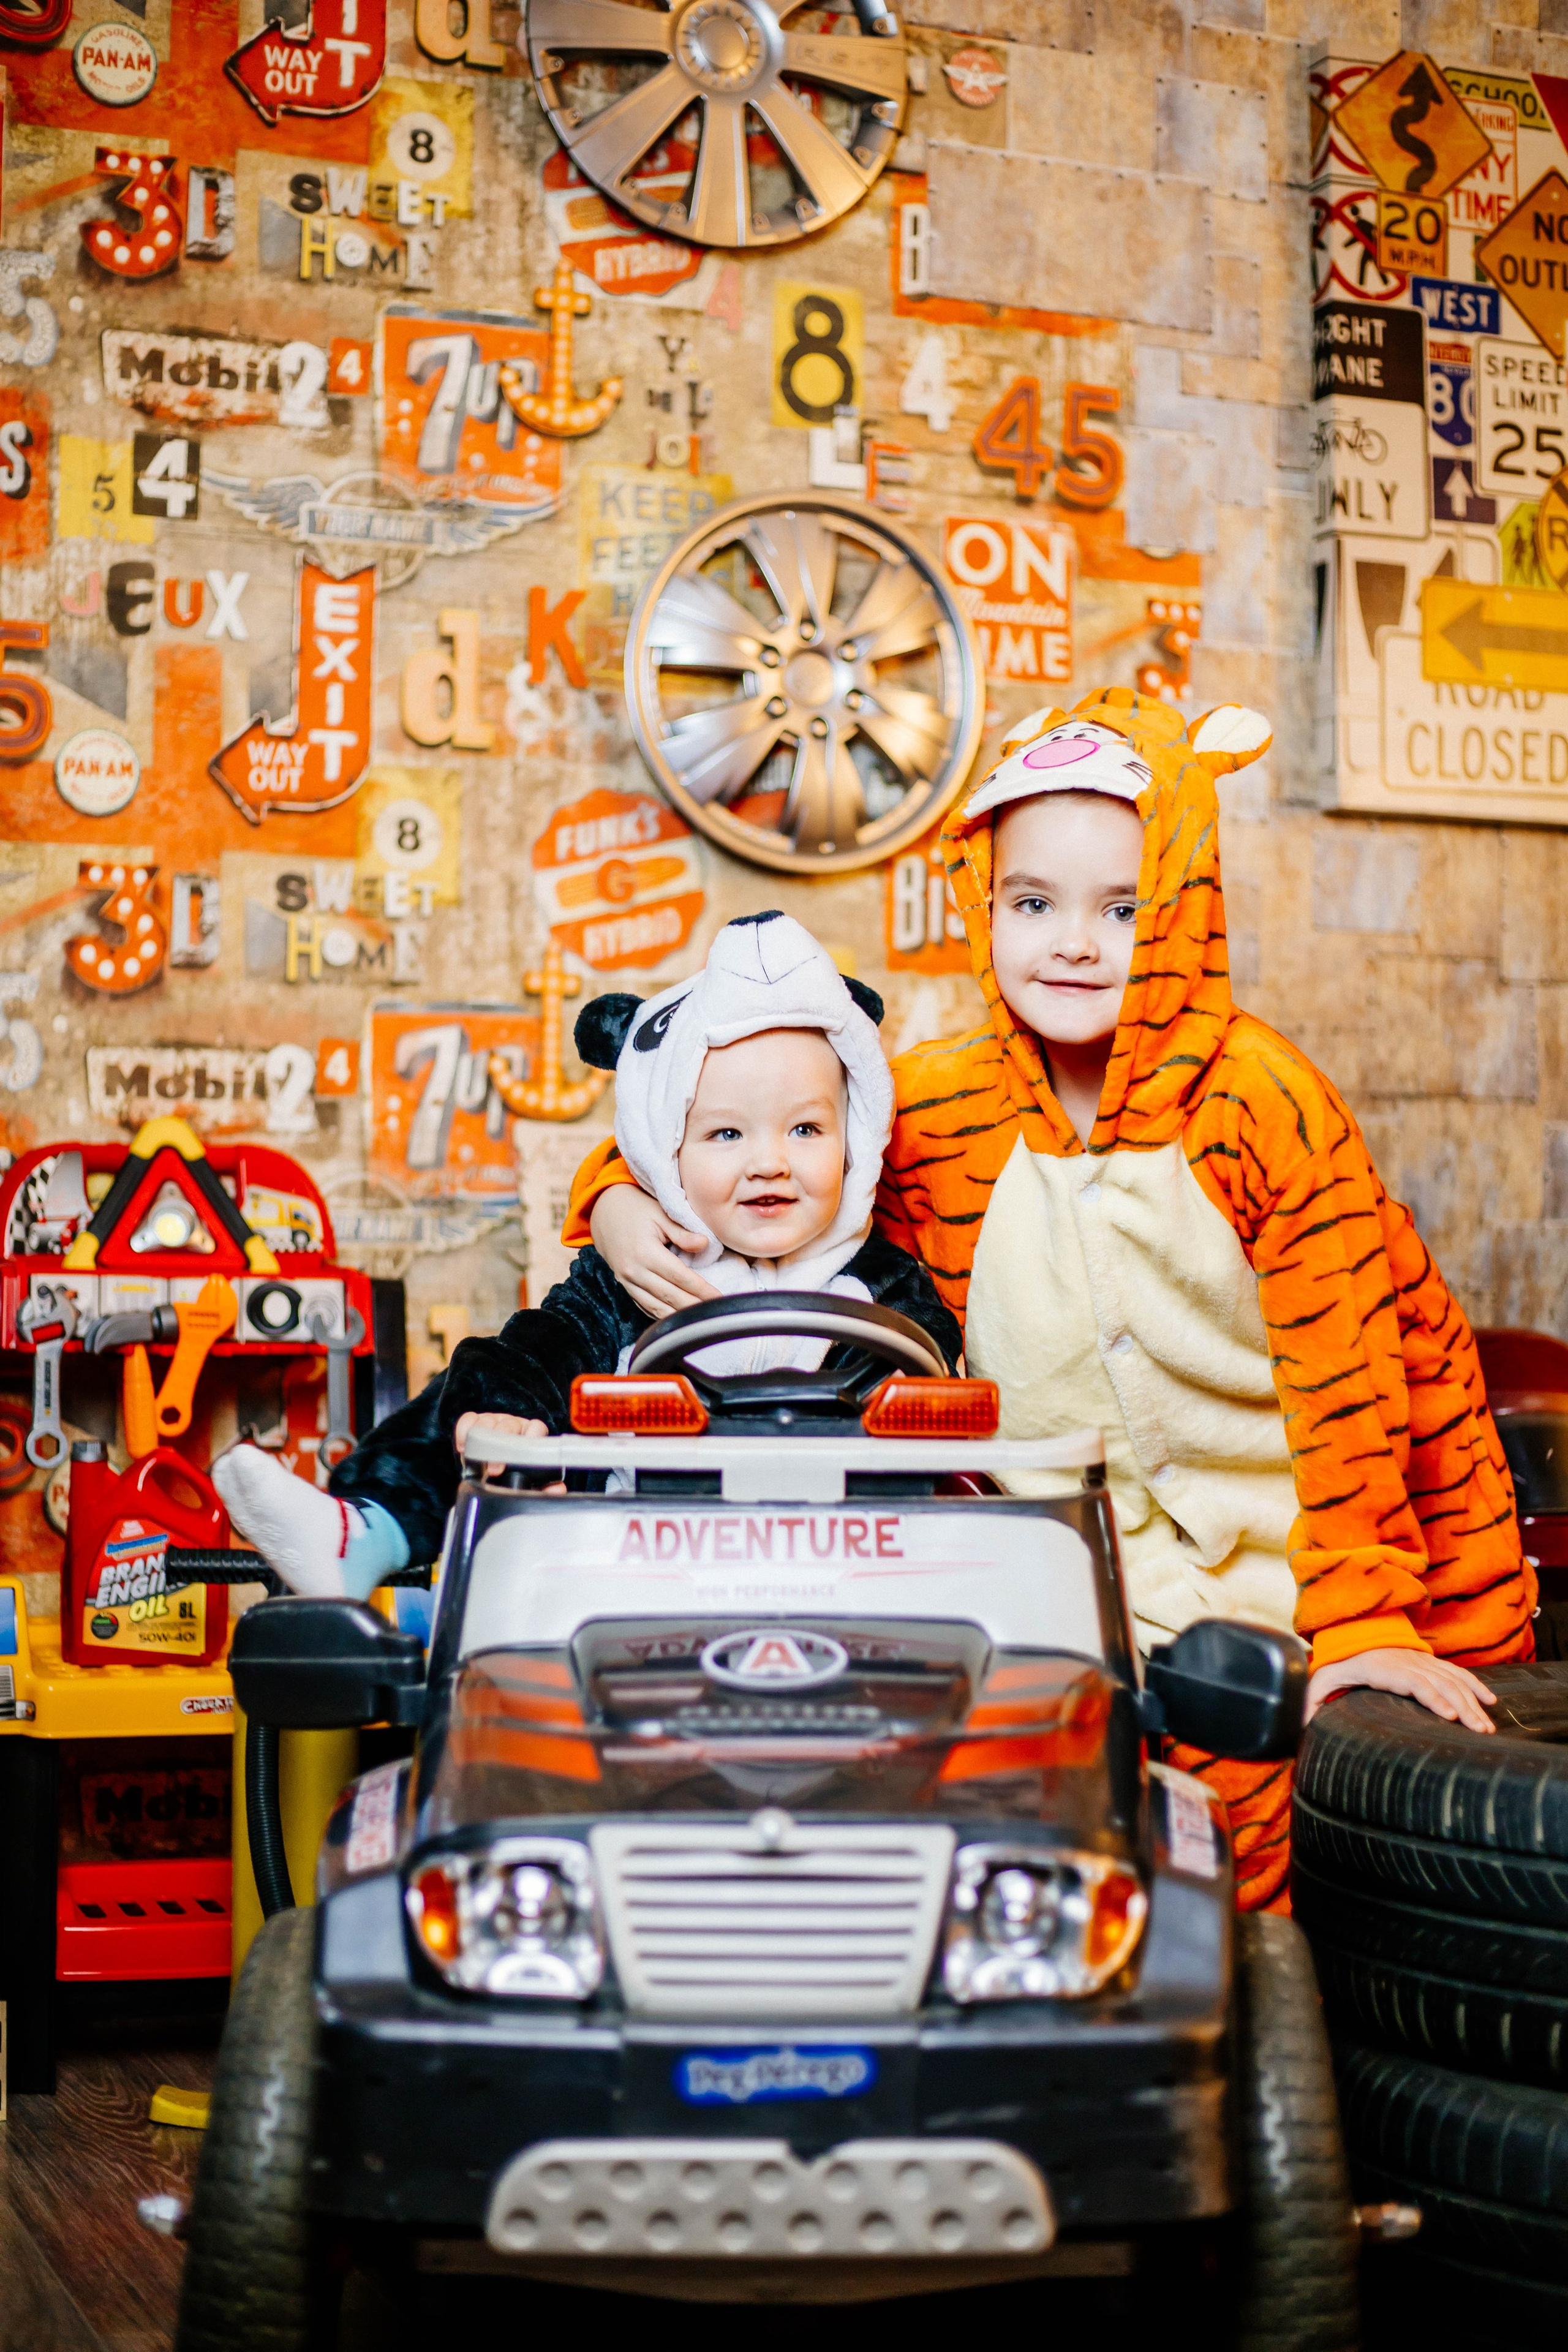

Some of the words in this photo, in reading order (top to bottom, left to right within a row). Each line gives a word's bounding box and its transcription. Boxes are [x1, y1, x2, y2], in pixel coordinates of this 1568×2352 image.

[82, 47, 151, 72] PAN-AM
[264, 45, 322, 74] WAY
[265, 70, 318, 96] OUT
[409, 129, 434, 163] 8
[290, 168, 452, 227] SWEET
[1384, 200, 1441, 245] 20
[1390, 249, 1435, 270] MPH
[707, 263, 743, 331] 4
[1420, 285, 1493, 328] WEST
[336, 348, 364, 386] 4
[781, 294, 854, 423] 8
[279, 341, 329, 426] 2
[900, 334, 955, 432] 4
[1494, 386, 1561, 415] LIMIT
[973, 375, 1125, 510] 45
[1493, 421, 1567, 479] 25
[91, 473, 116, 513] 5
[137, 439, 195, 518] 4
[600, 481, 715, 526] KEEP
[948, 522, 1068, 601] ON
[61, 562, 250, 640] JEUX
[528, 586, 590, 688] K
[309, 584, 360, 782] EXIT
[402, 608, 495, 749] d
[247, 741, 308, 768] WAY
[1408, 723, 1568, 783] CLOSED
[248, 766, 304, 794] OUT
[397, 818, 420, 852] 8
[597, 859, 635, 904] G
[265, 1044, 316, 1132] 2
[323, 1047, 351, 1086] 4
[619, 1517, 904, 1560] ADVENTURE
[129, 1594, 170, 1623] OIL
[743, 1638, 807, 1672] A
